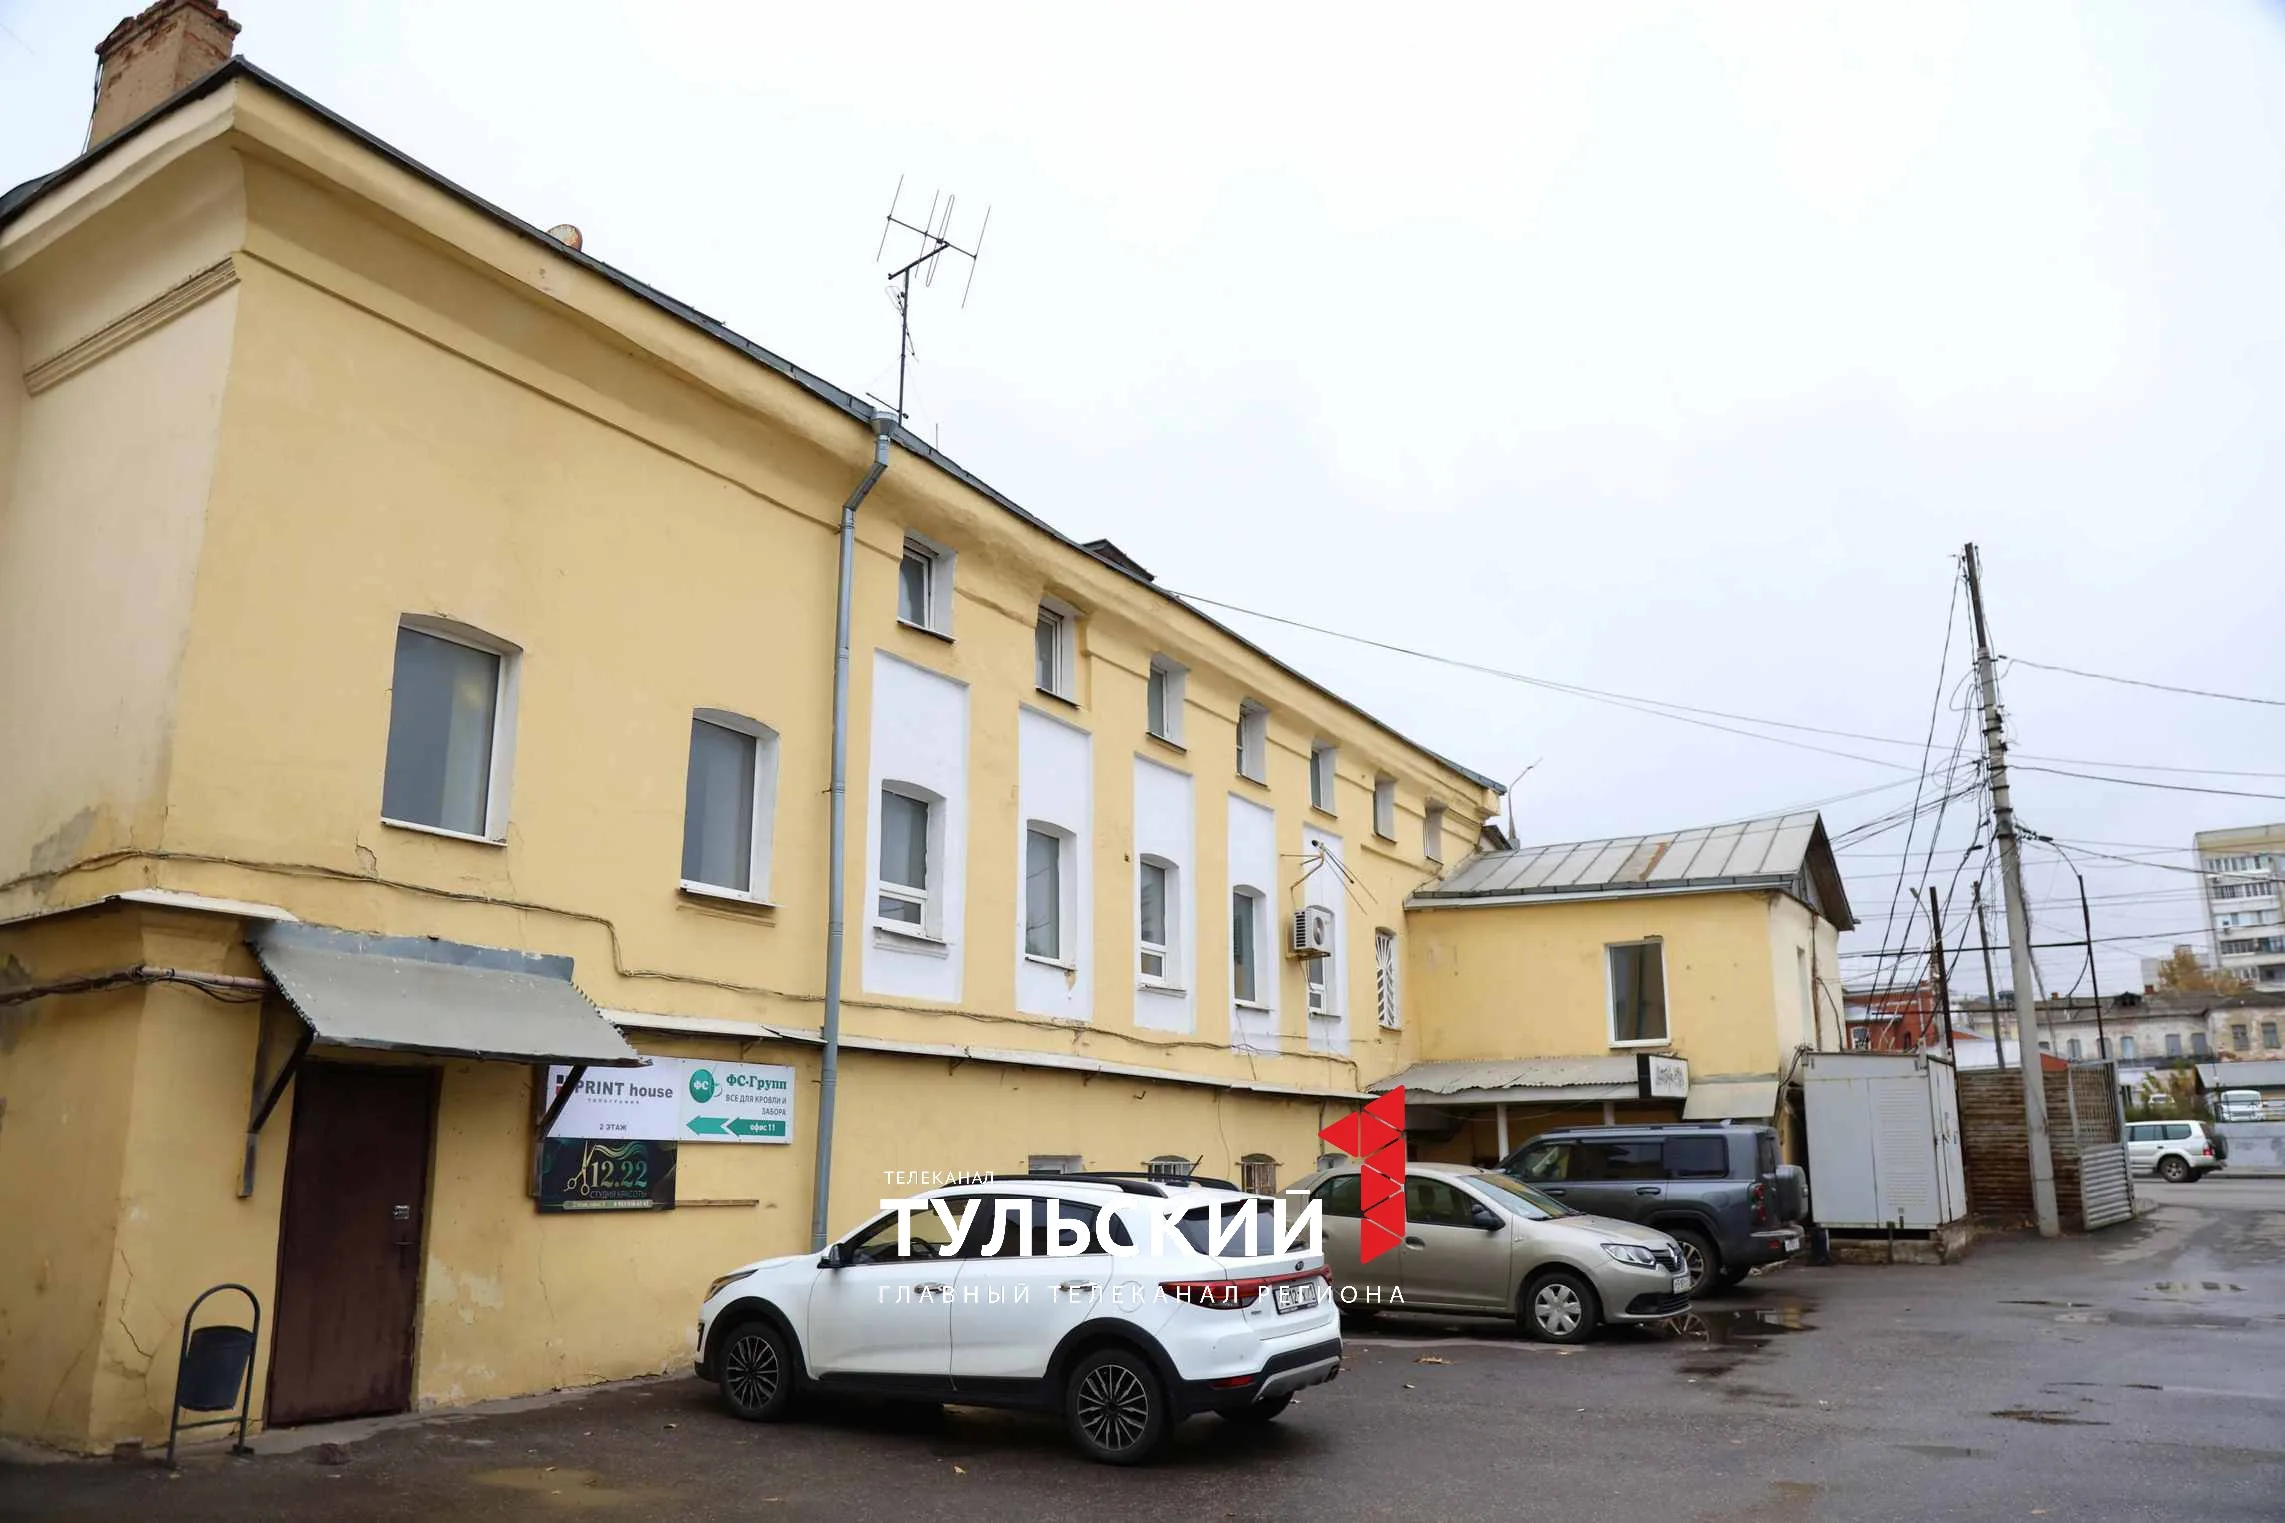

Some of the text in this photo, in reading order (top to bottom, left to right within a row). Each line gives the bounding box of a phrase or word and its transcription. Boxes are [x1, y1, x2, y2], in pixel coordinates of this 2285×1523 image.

[726, 1073, 787, 1091] ФС-Групп
[575, 1080, 673, 1098] PRINT house
[725, 1094, 738, 1102] ВСЕ
[739, 1095, 754, 1103] ДЛЯ
[755, 1095, 779, 1104] КРОВЛИ
[761, 1107, 786, 1116] ЗАБОРА
[606, 1123, 627, 1132] ЭТАЖ
[750, 1122, 776, 1133] офис 11
[590, 1160, 648, 1188] 12.22
